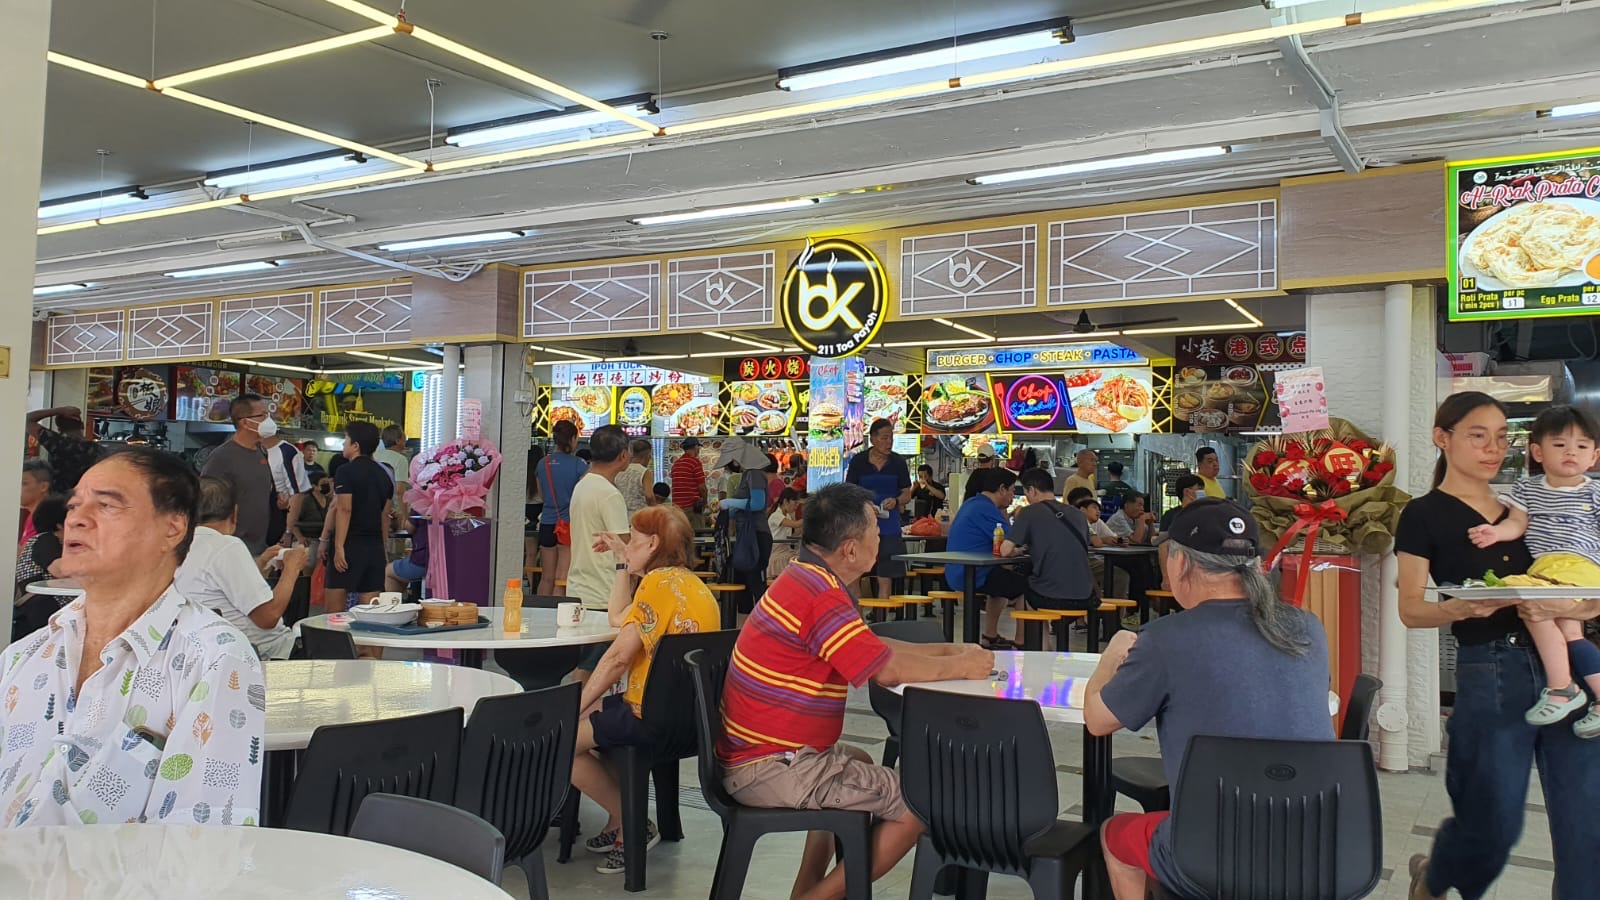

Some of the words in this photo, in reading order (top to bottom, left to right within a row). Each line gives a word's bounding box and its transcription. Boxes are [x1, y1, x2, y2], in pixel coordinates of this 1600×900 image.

[1535, 177, 1584, 202] Prata
[1462, 278, 1474, 289] 01
[1478, 292, 1499, 302] Prata
[1540, 295, 1556, 305] Egg
[1558, 293, 1580, 303] Prata
[817, 344, 835, 355] 211
[836, 339, 855, 353] Toa
[853, 312, 878, 343] Payoh
[937, 354, 986, 367] BURGER
[994, 351, 1032, 364] CHOP
[1040, 348, 1083, 363] STEAK
[1093, 346, 1137, 361] PASTA
[591, 362, 615, 371] IPOH
[1017, 382, 1054, 403] Chop
[809, 453, 841, 468] BURGER
